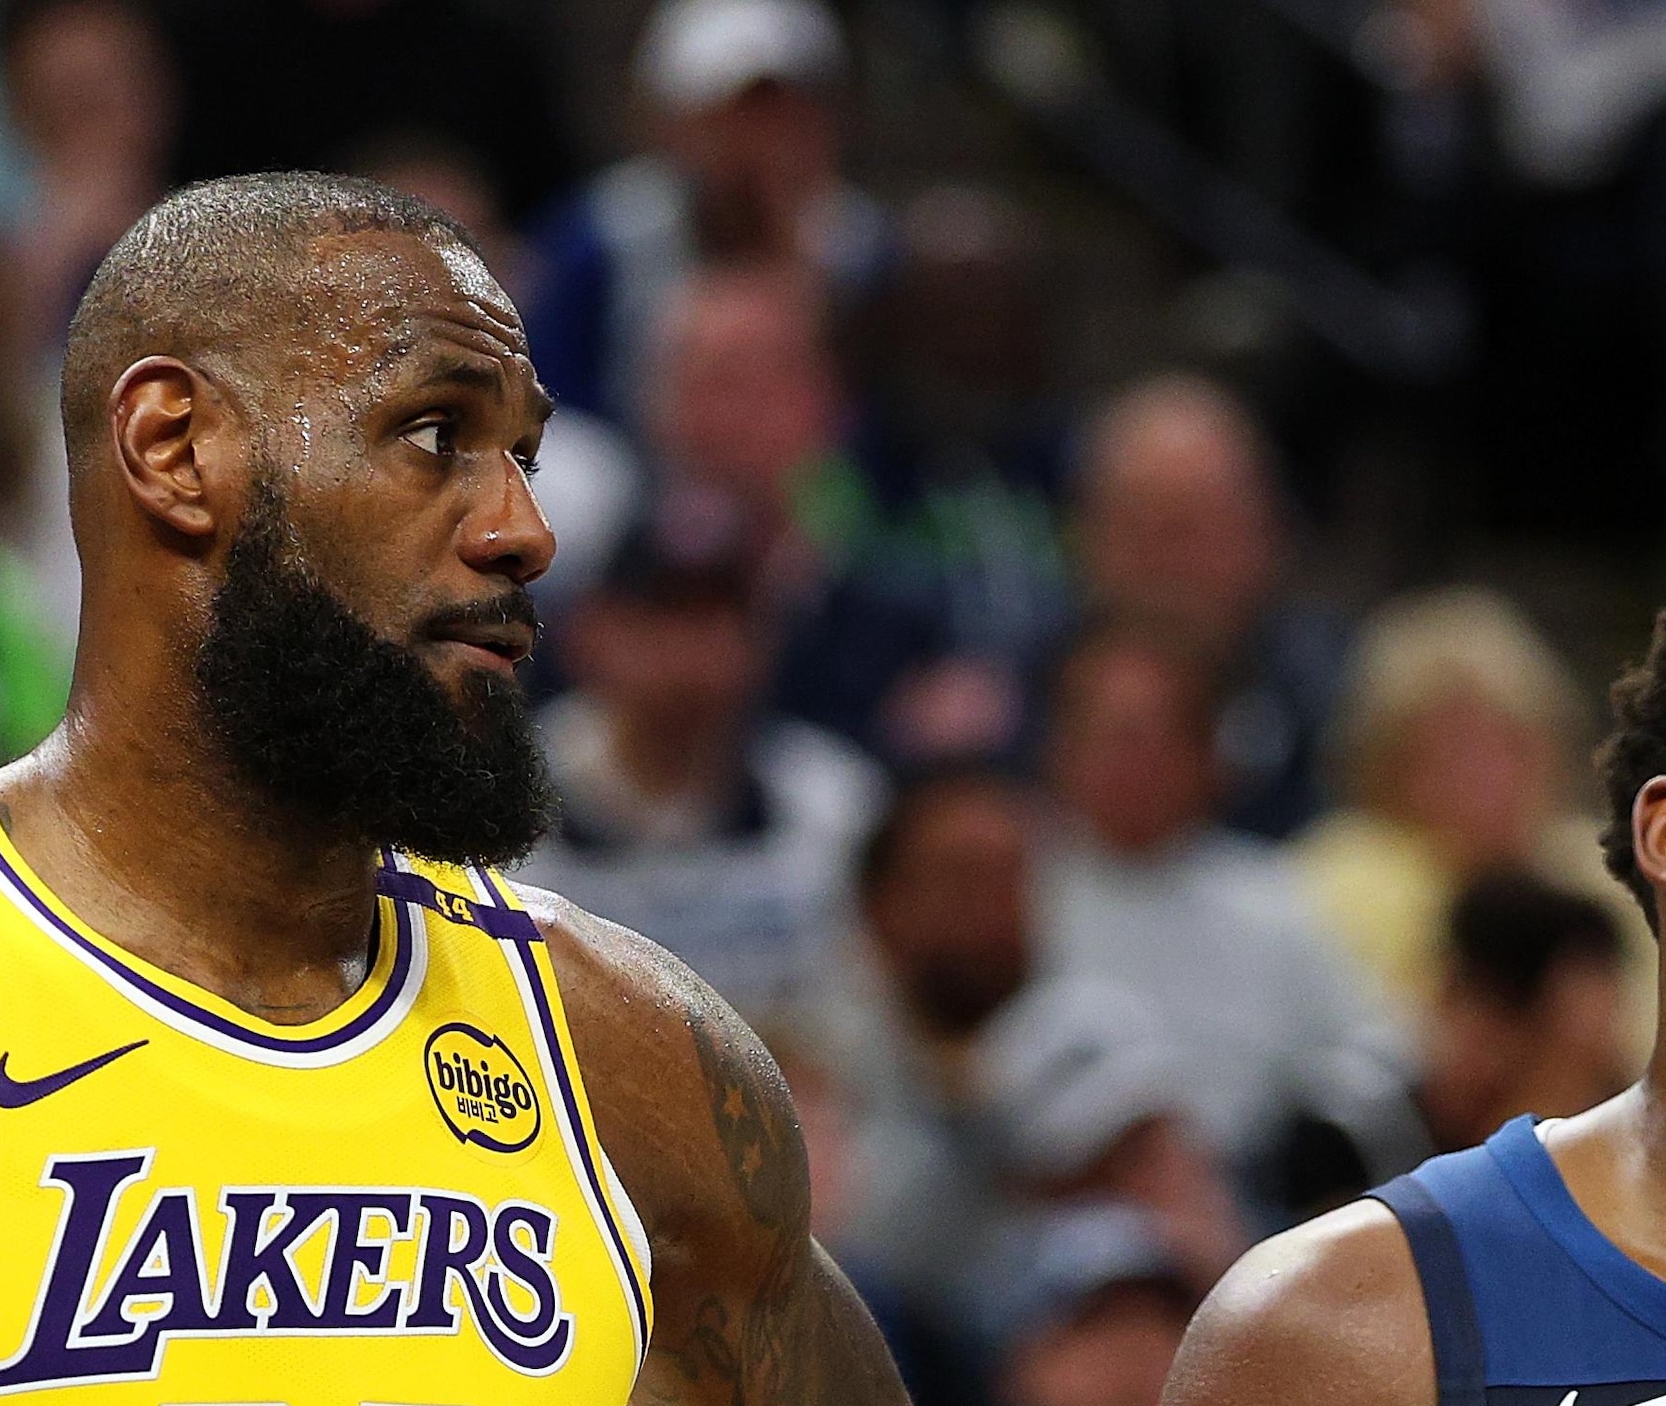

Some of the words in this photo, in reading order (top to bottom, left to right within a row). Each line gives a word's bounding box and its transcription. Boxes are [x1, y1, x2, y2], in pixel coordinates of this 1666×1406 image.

[435, 890, 474, 922] 44
[433, 1051, 532, 1119] bibigo
[456, 1096, 499, 1123] 비비고
